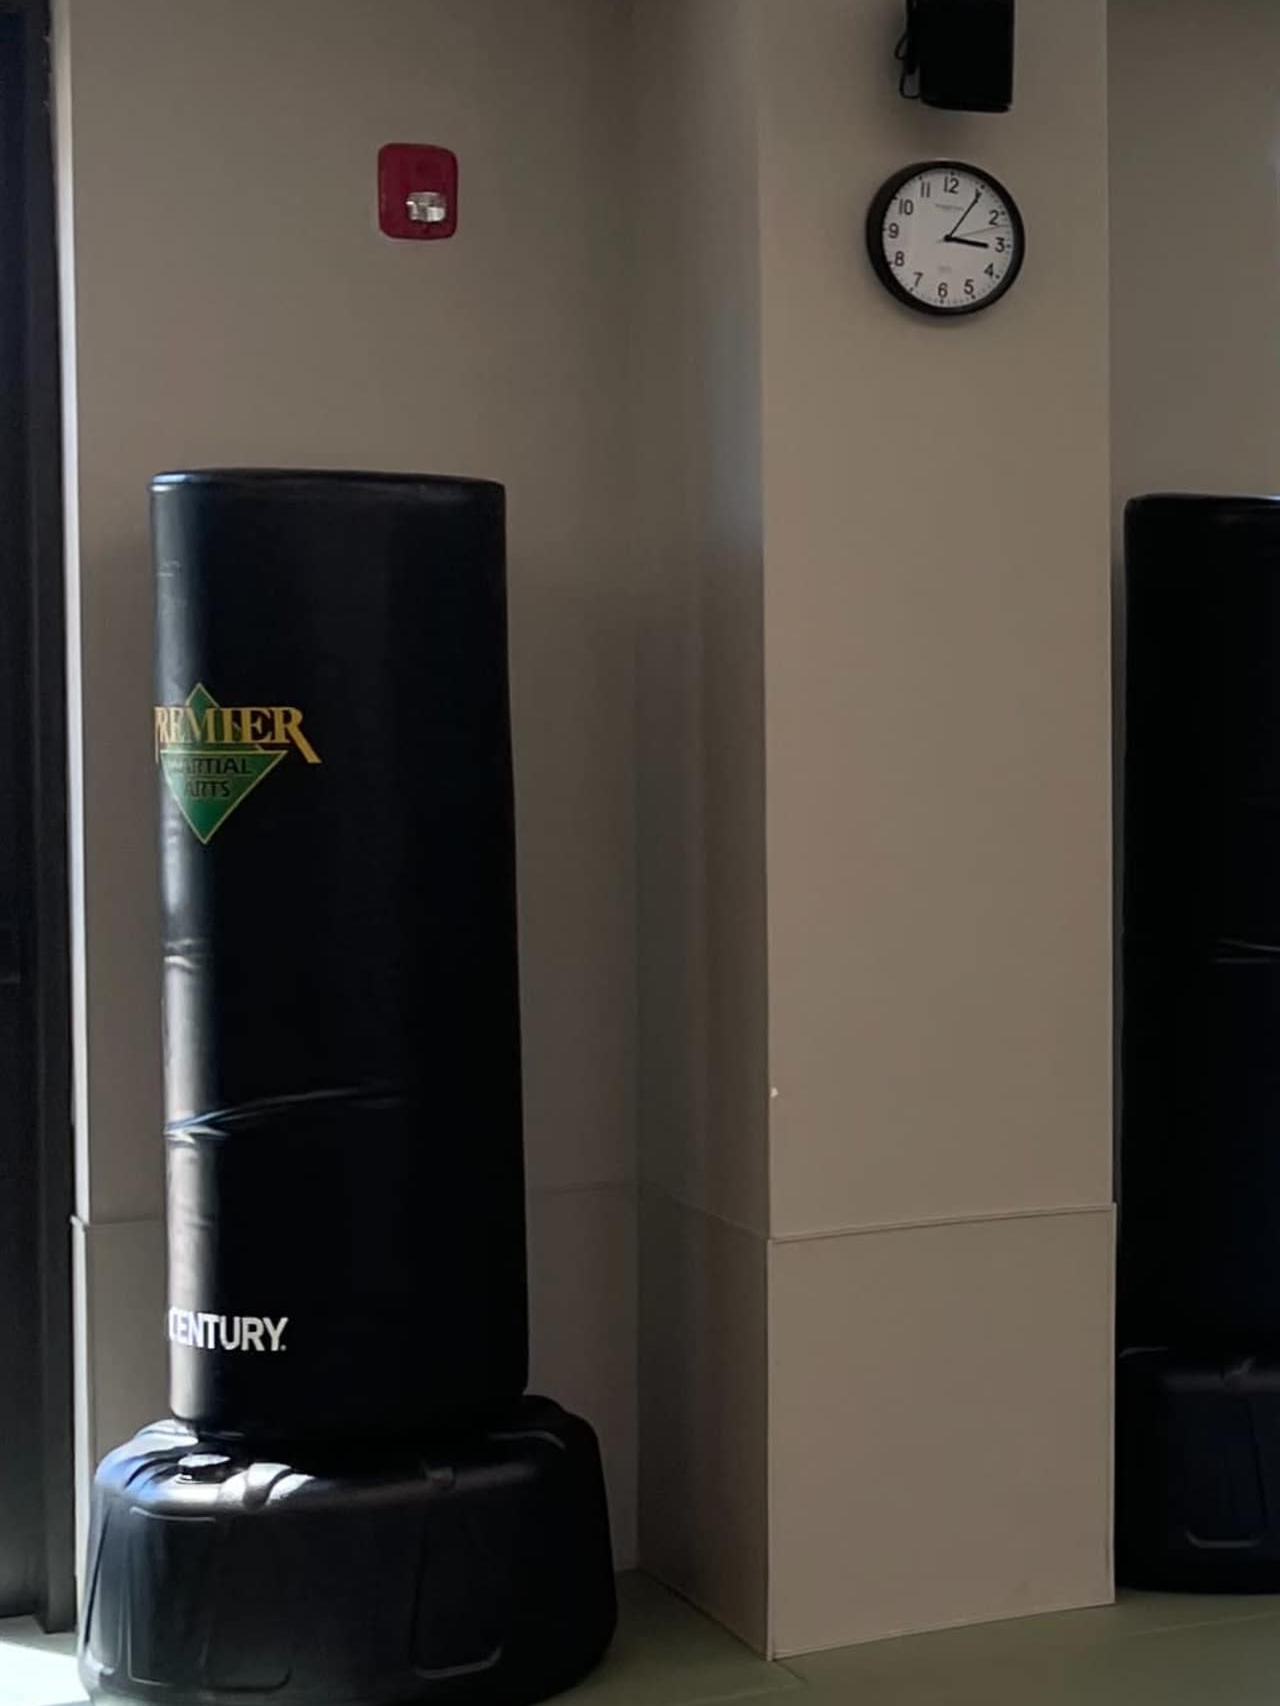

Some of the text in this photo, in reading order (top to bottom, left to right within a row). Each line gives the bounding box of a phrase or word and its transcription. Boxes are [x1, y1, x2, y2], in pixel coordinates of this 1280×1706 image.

[920, 181, 931, 198] 11
[943, 176, 960, 194] 12
[898, 199, 914, 215] 10
[988, 209, 999, 226] 2
[888, 223, 899, 238] 9
[994, 237, 1005, 253] 3
[894, 251, 905, 266] 8
[983, 262, 994, 277] 4
[912, 271, 924, 287] 7
[963, 279, 975, 295] 5
[937, 282, 949, 298] 6
